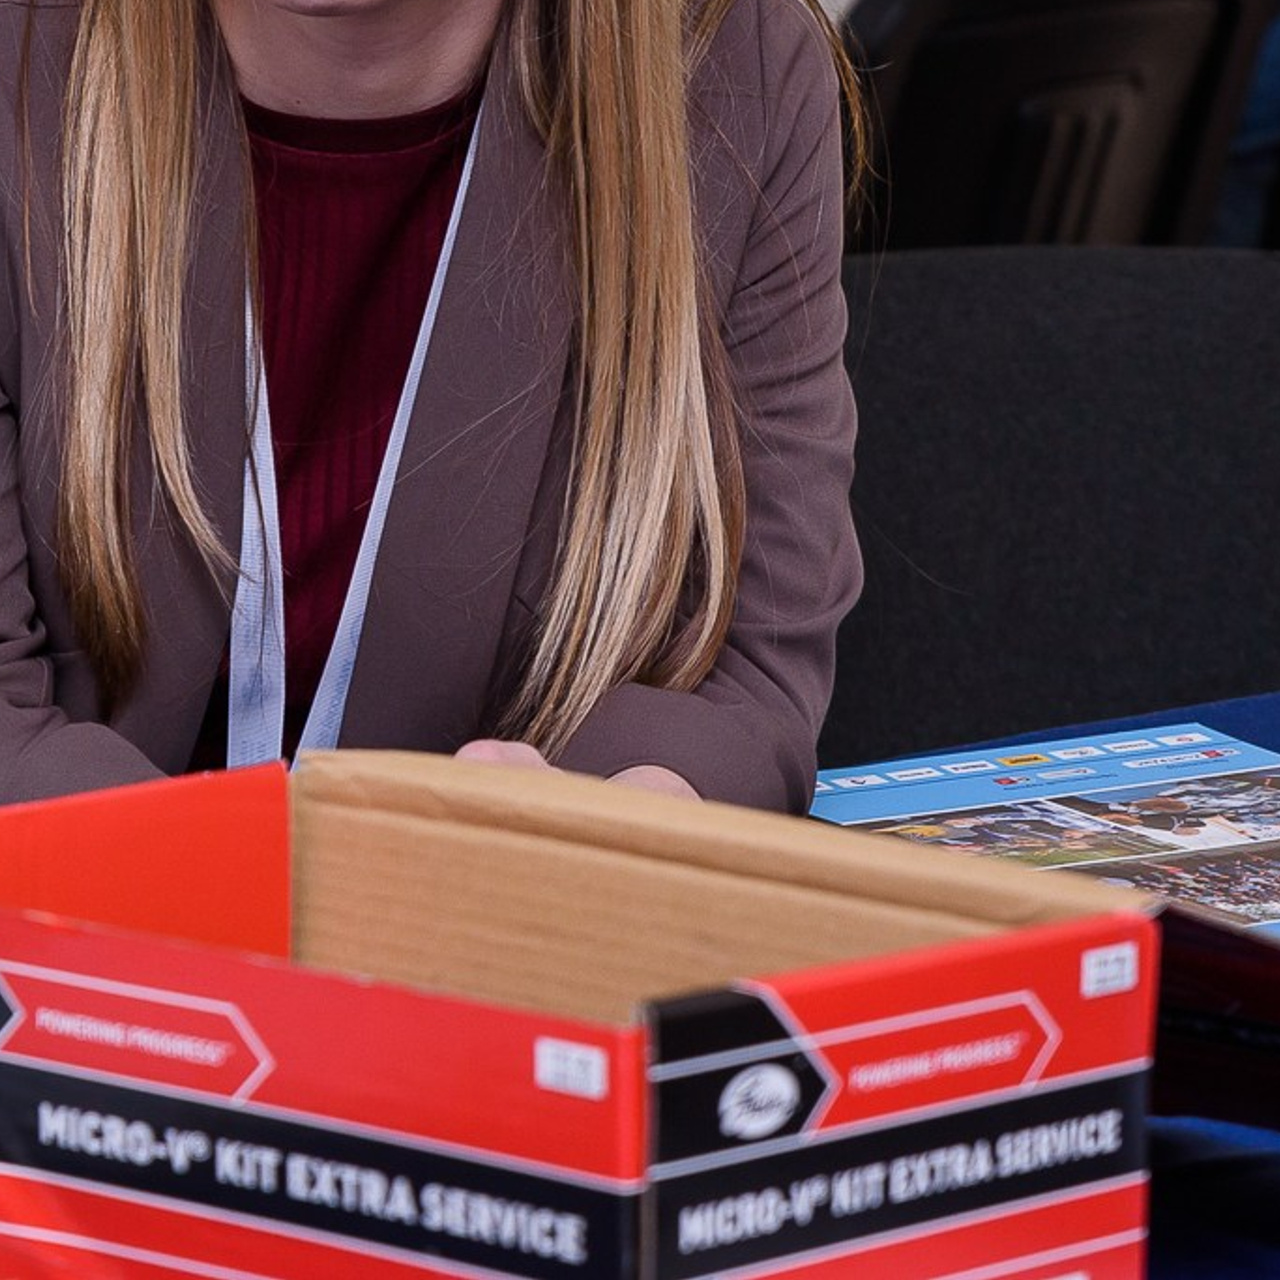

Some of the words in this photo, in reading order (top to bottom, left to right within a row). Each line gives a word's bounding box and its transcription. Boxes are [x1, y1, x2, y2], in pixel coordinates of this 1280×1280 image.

[214, 1137, 282, 1193] KIT
[285, 1152, 418, 1225] EXTRA
[420, 1181, 588, 1265] SERVICE
[831, 1161, 887, 1218] KIT
[888, 1137, 995, 1204] EXTRA
[994, 1108, 1123, 1178] SERVICE
